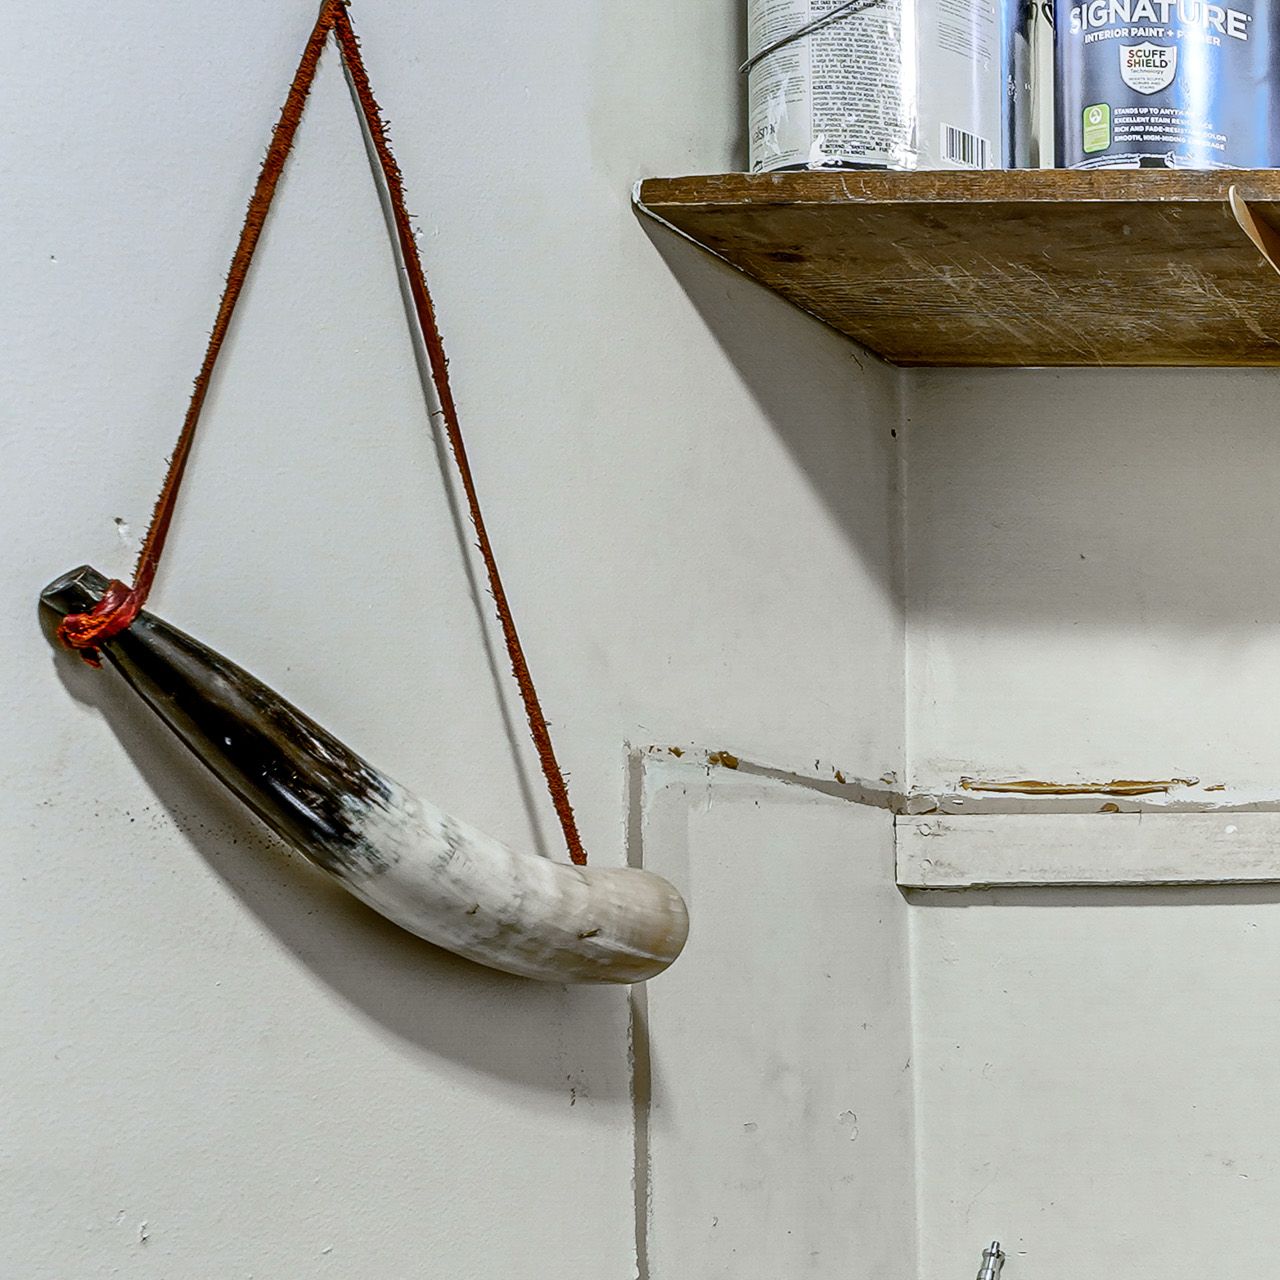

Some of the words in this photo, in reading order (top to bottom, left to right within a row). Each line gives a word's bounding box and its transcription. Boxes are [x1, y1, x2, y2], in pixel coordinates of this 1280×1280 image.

[1069, 0, 1248, 41] SIGNATURE
[1085, 28, 1129, 44] INTERIOR
[1130, 27, 1165, 38] PAINT
[1176, 31, 1222, 47] PER
[1128, 49, 1167, 58] SCUFF
[1127, 58, 1168, 68] SHIELD
[1114, 107, 1139, 115] STANDS
[1114, 116, 1150, 124] EXCELLENT
[1150, 116, 1171, 124] STAIN
[1114, 125, 1129, 133] RICH
[1129, 125, 1145, 133] AND
